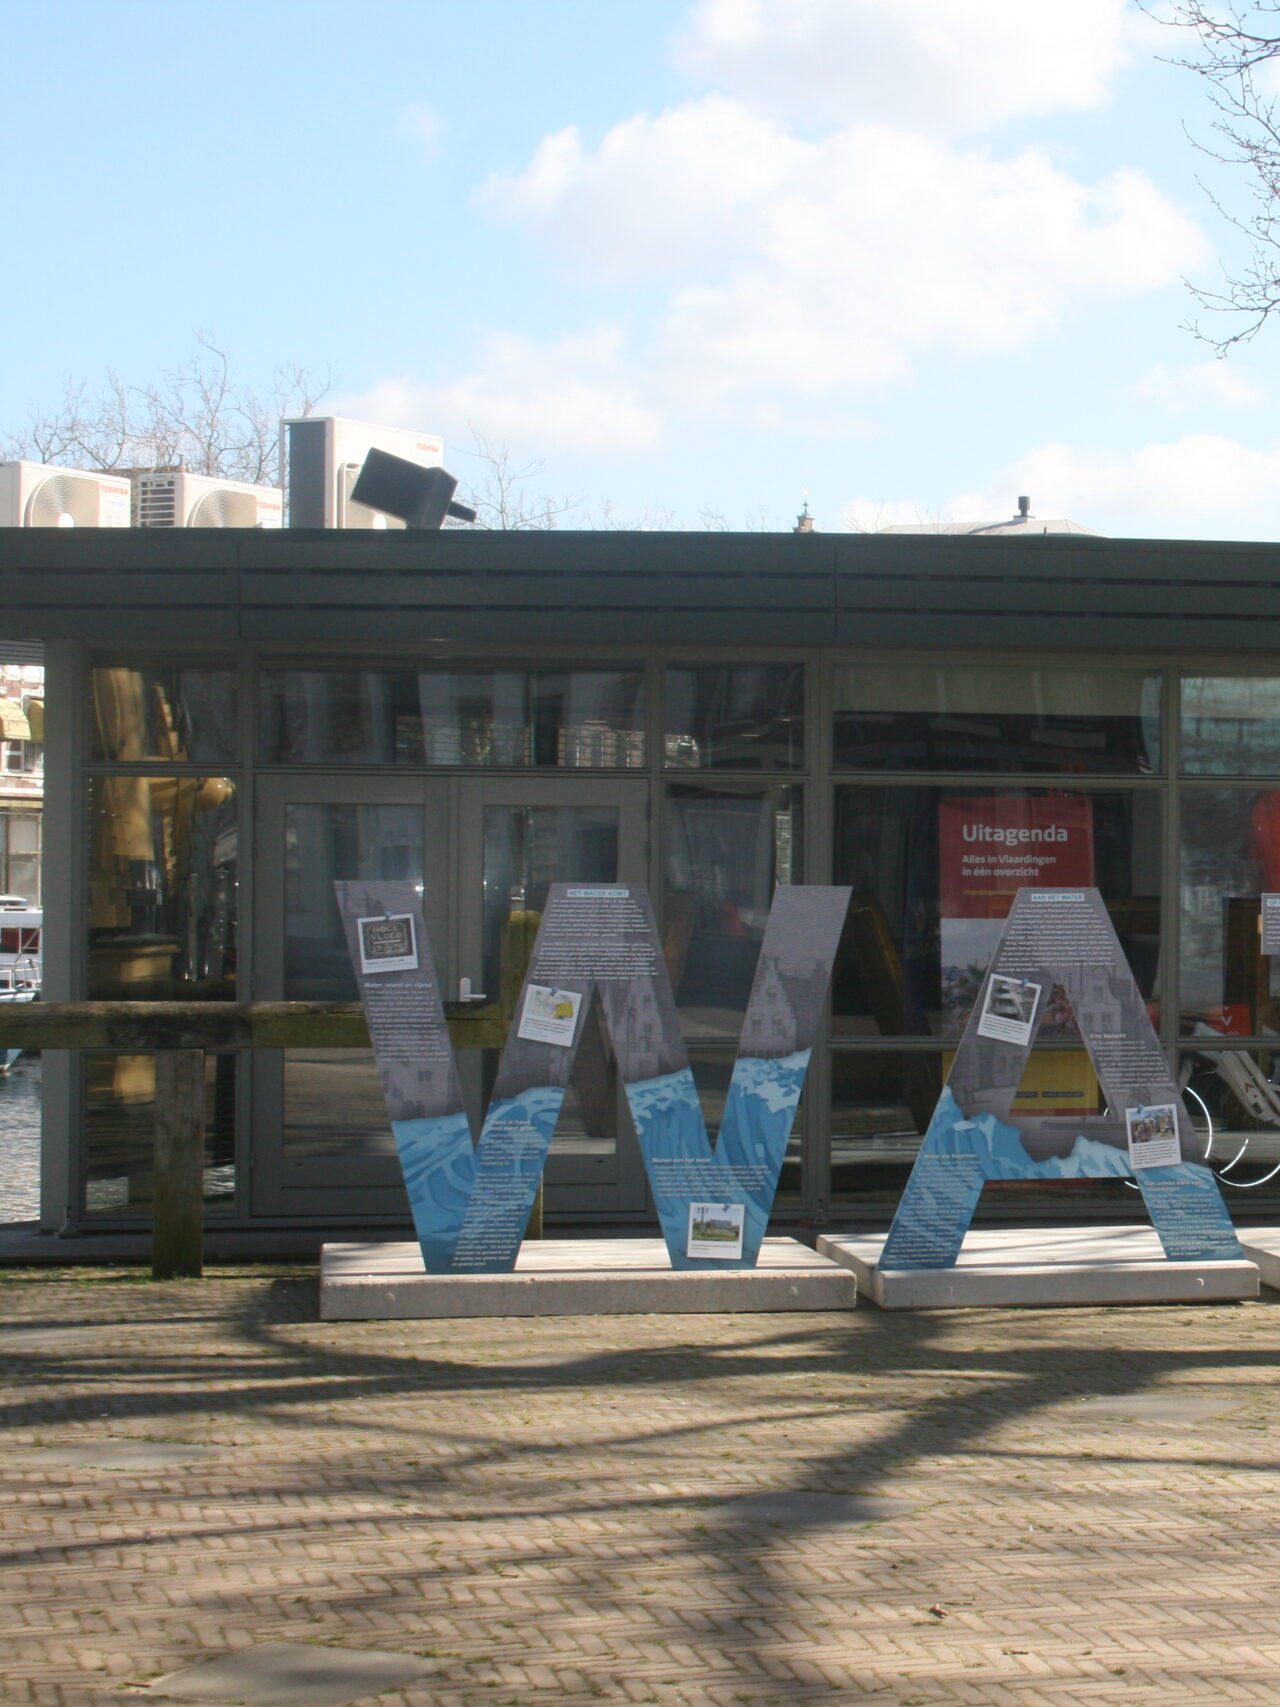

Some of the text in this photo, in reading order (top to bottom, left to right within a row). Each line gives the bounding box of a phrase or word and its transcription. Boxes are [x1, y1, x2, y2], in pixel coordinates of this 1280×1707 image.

[100, 484, 129, 495] TOSHIBA
[962, 824, 1068, 846] Uitagenda
[962, 855, 1056, 865] Alles in Vlaardingen
[962, 867, 1039, 876] in één overzicht
